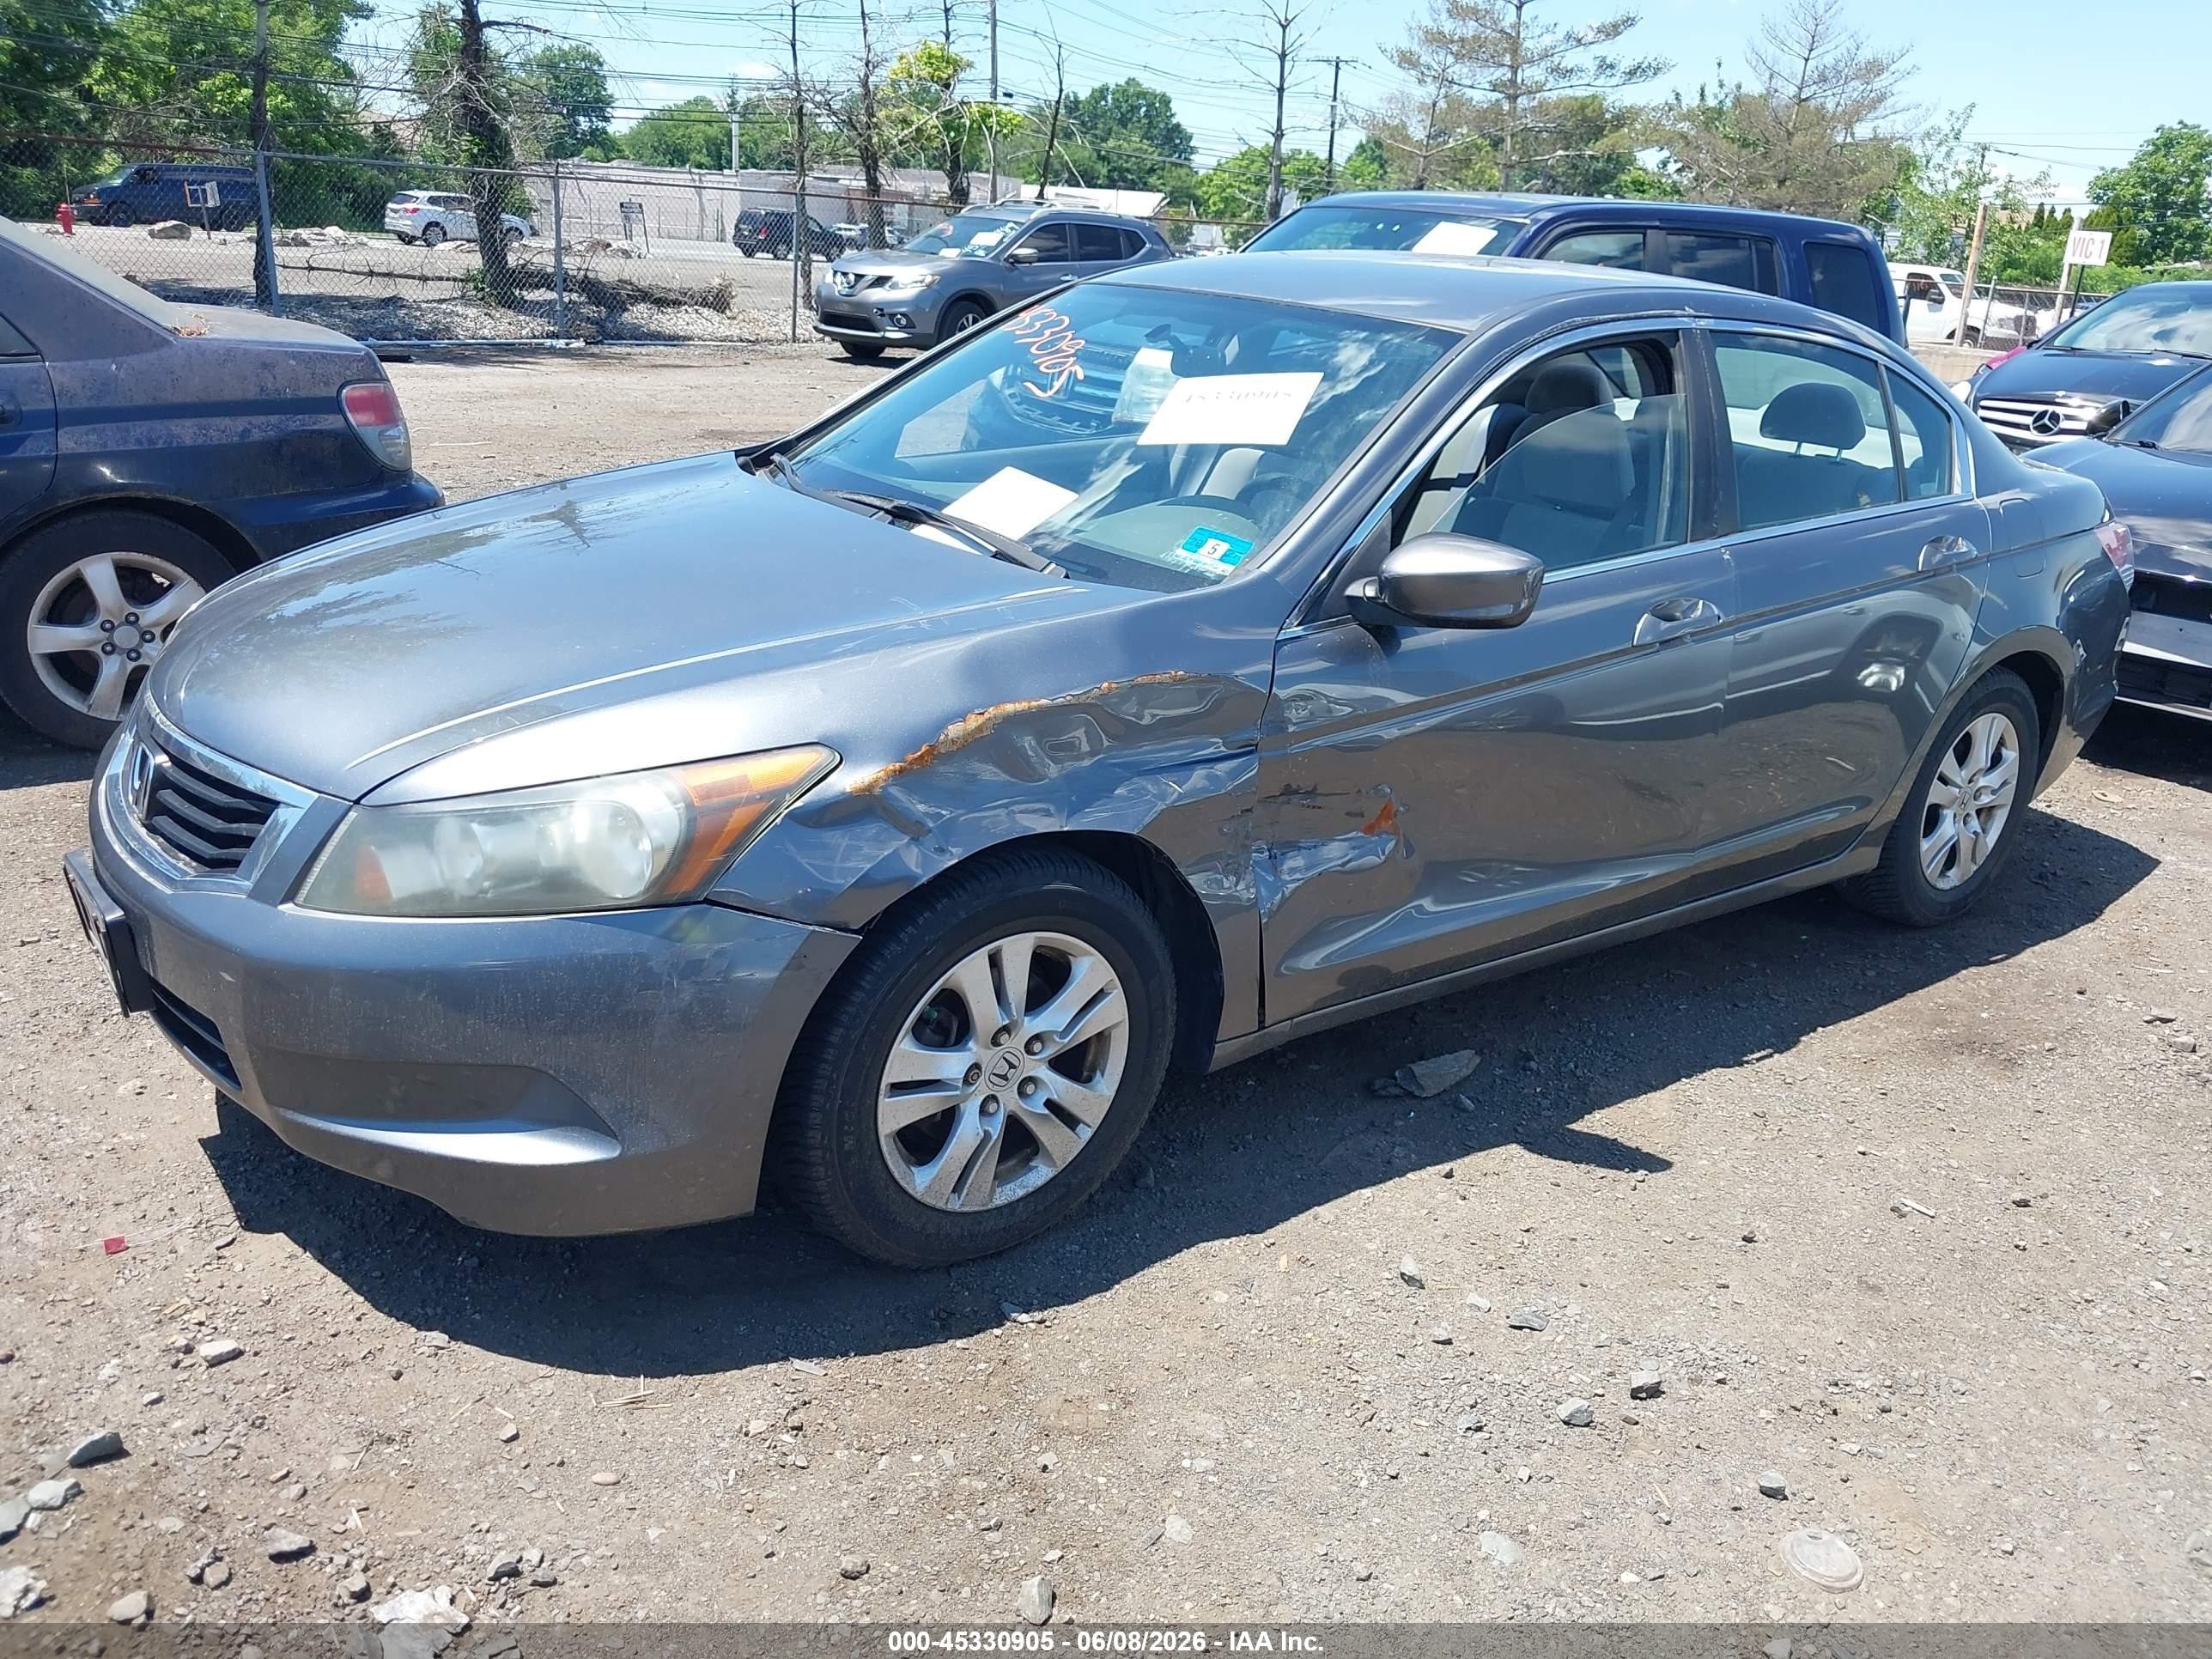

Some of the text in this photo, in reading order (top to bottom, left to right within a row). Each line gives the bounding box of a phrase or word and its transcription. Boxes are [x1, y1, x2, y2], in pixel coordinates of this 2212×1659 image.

[2071, 236, 2106, 260] VIC 1
[1207, 544, 1220, 555] 5
